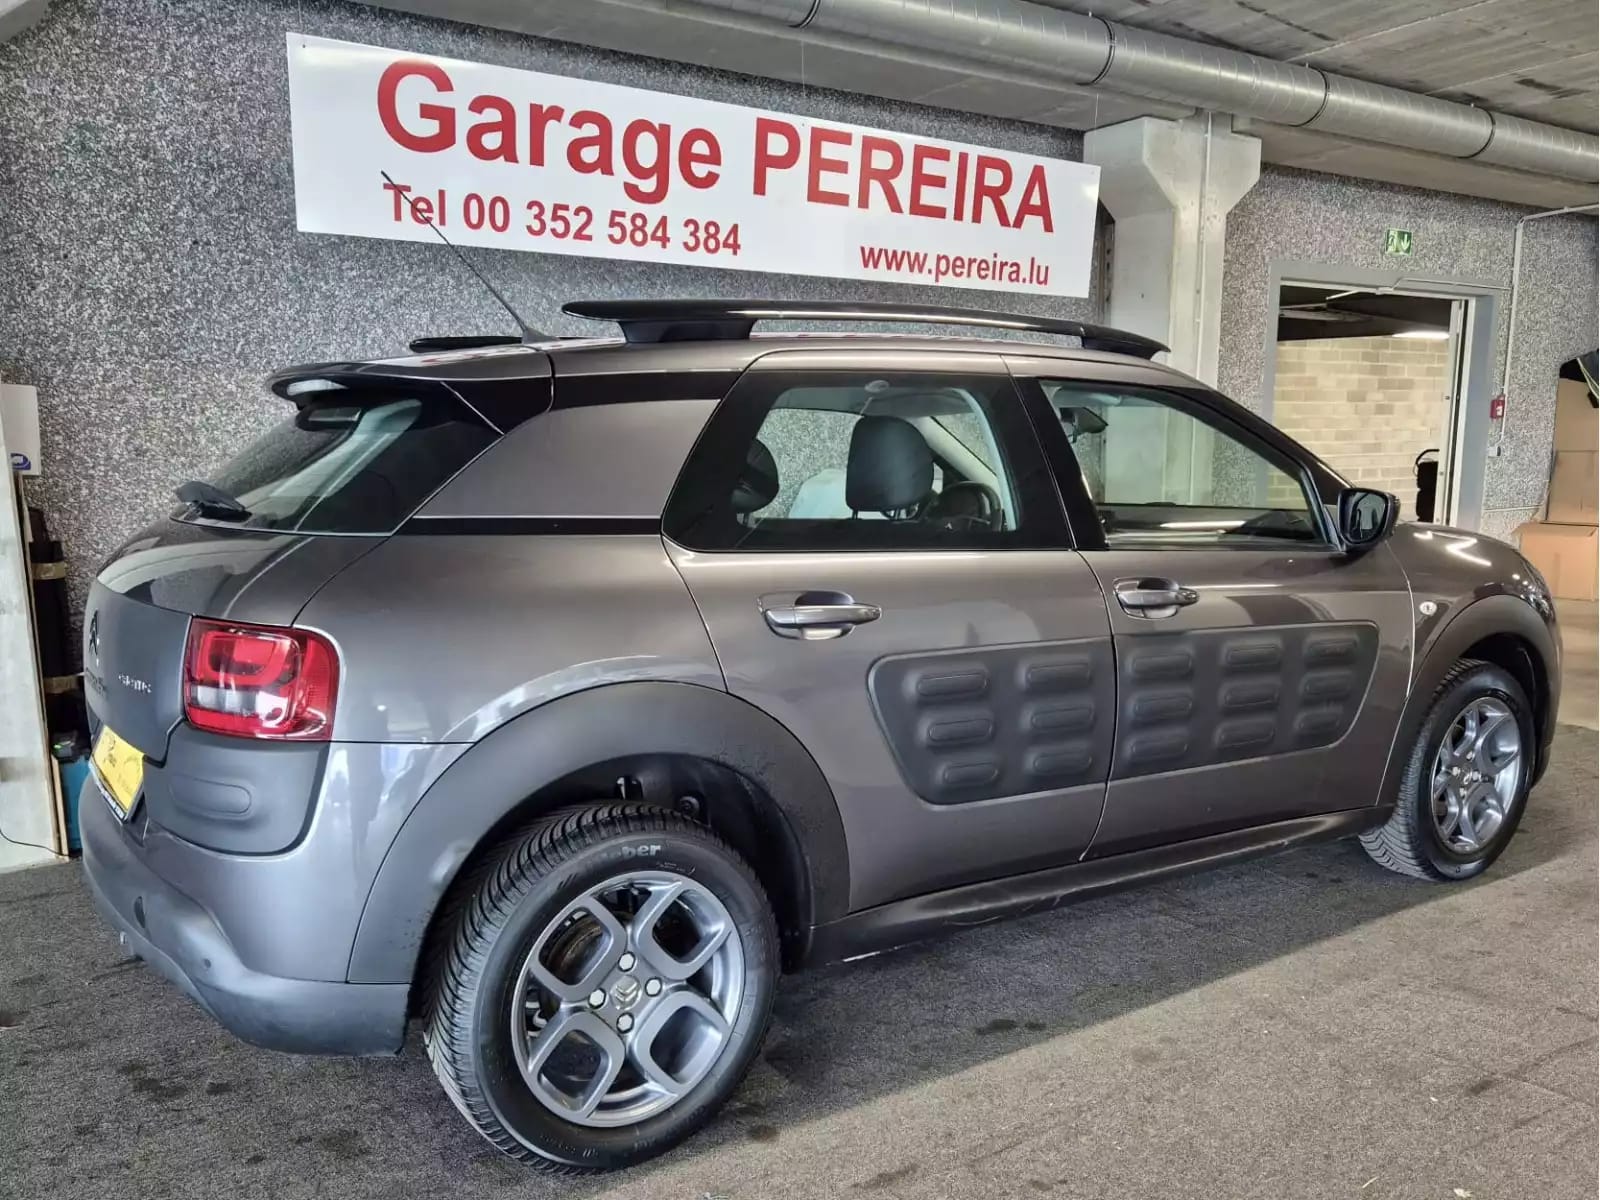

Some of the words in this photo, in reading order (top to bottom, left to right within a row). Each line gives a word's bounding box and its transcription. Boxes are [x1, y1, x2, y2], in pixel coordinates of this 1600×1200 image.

[377, 59, 723, 206] Garage
[752, 116, 1055, 234] PEREIRA
[383, 183, 446, 226] Tel
[463, 193, 511, 233] 00
[526, 200, 594, 243] 352
[607, 209, 671, 250] 584
[682, 218, 742, 256] 384
[860, 245, 1051, 287] www.pereira.lu
